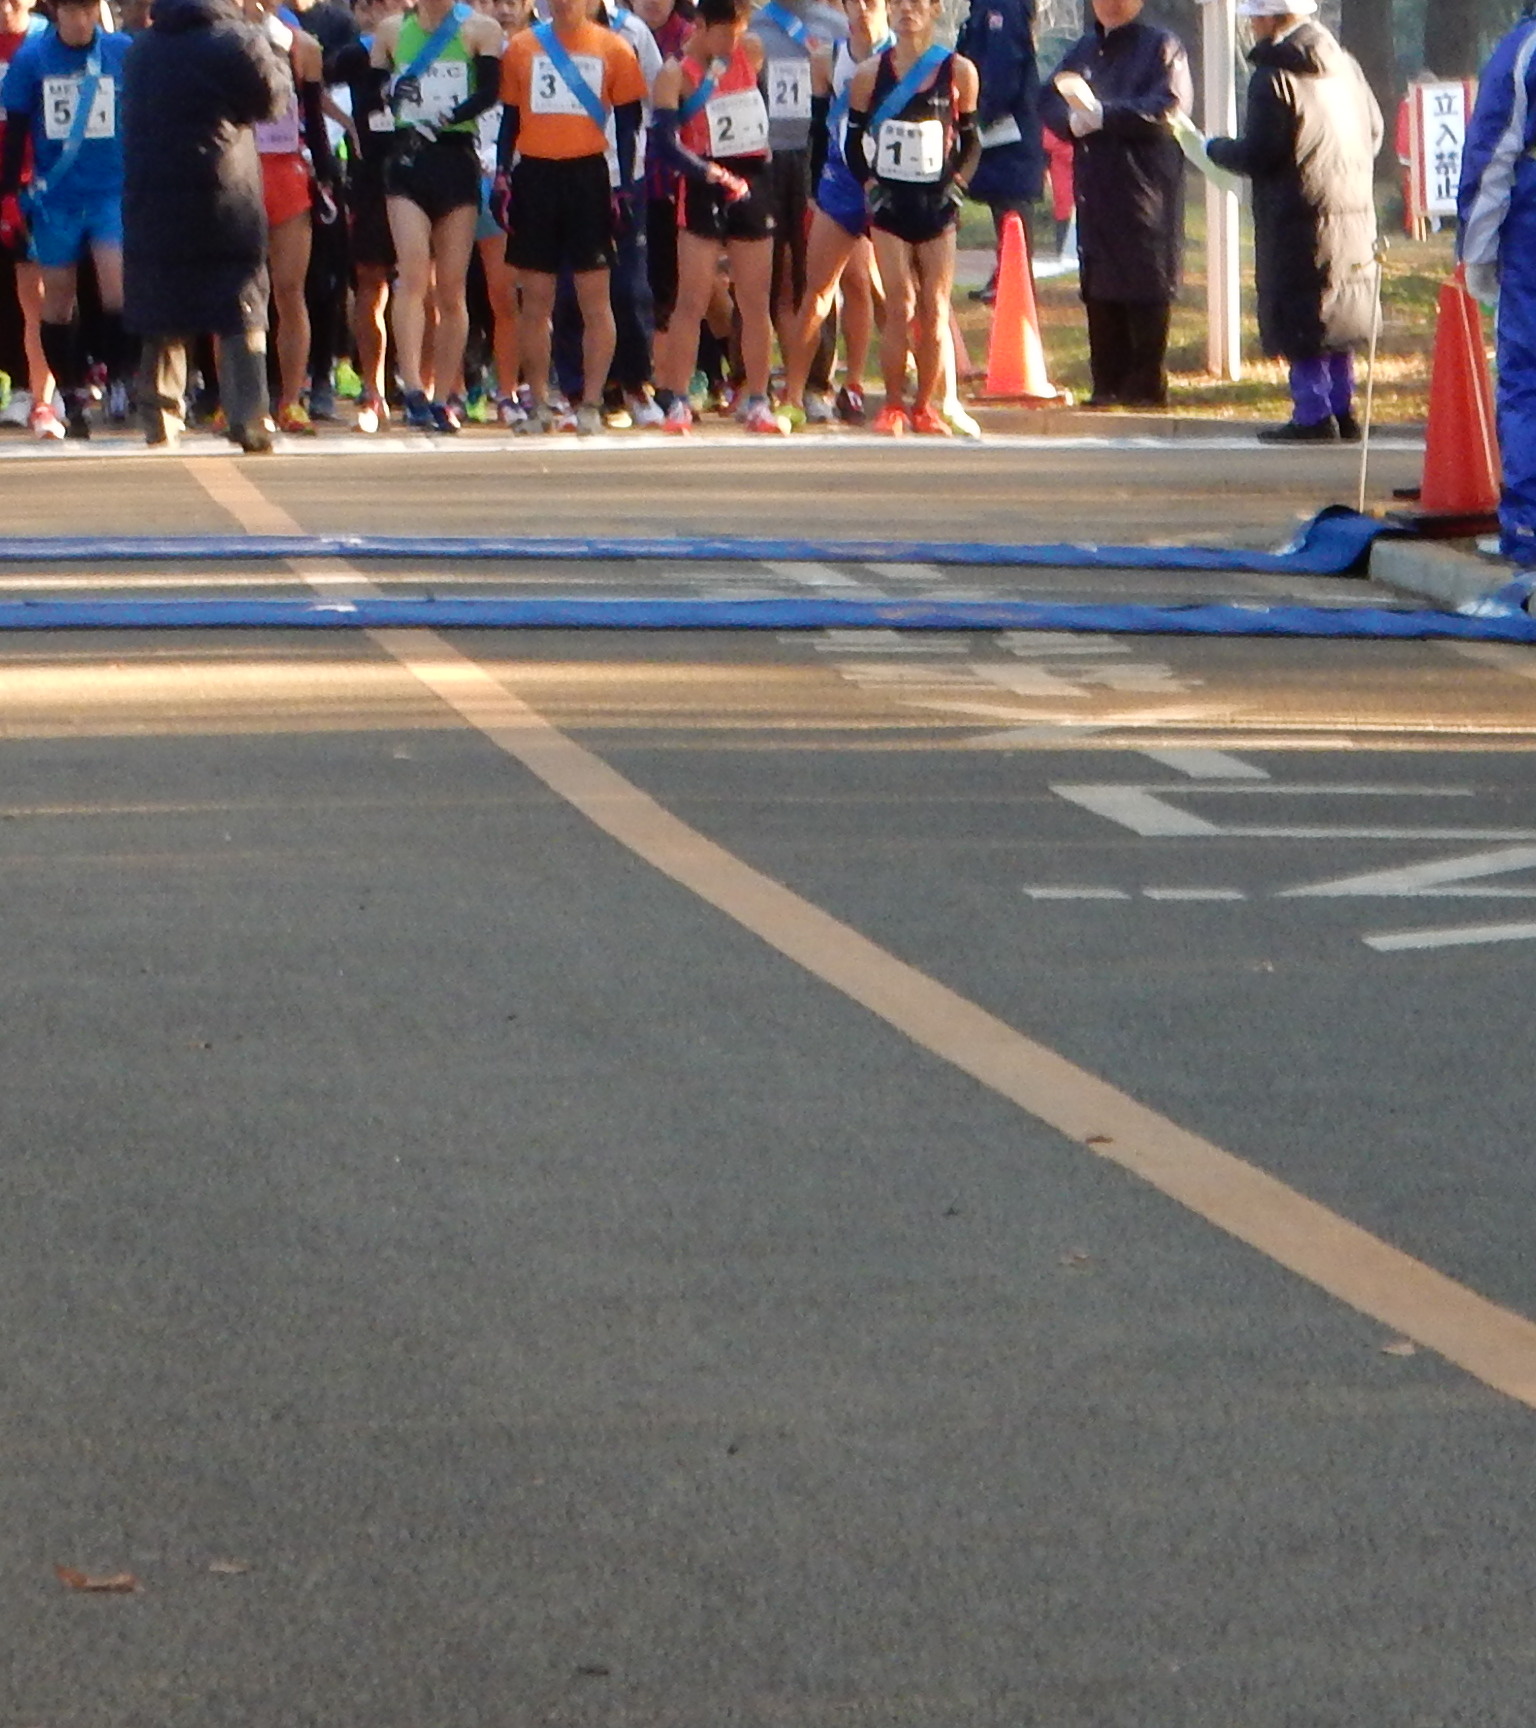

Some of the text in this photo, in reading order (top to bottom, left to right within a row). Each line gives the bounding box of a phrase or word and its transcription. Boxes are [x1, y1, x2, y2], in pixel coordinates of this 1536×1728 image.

[539, 74, 557, 99] 3
[775, 79, 800, 105] 21
[1433, 92, 1461, 201] 立入禁止
